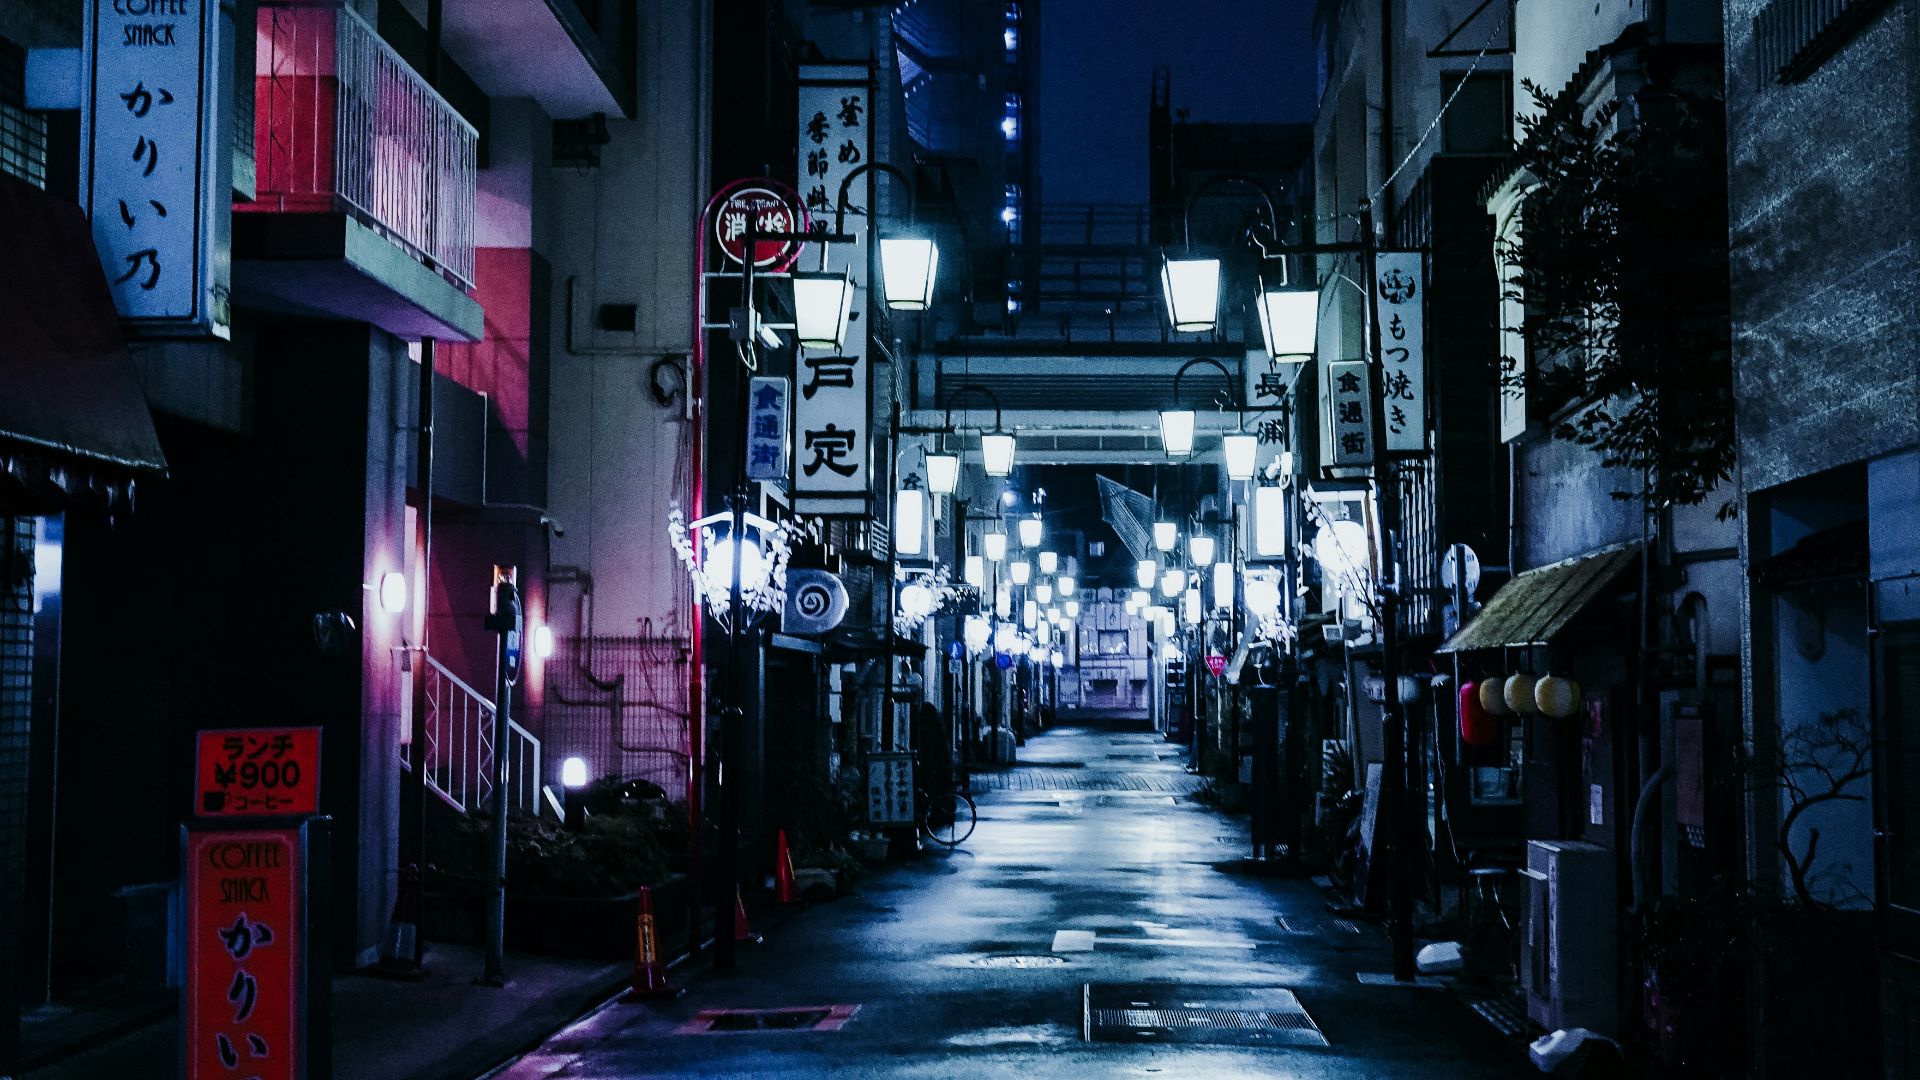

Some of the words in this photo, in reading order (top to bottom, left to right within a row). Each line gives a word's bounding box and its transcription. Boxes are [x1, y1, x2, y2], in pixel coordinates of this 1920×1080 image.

[113, 0, 187, 15] COFFEE
[122, 23, 176, 47] SNACK
[114, 80, 174, 291] かりい乃
[725, 211, 787, 242] 消栓
[1384, 313, 1414, 434] もつ焼き
[803, 312, 860, 477] 戸定
[1336, 371, 1365, 454] 食通街
[1255, 373, 1288, 487] 長浦
[222, 735, 294, 760] ランチ
[215, 760, 300, 788] ¥900
[236, 794, 294, 810] コーヒー
[209, 844, 281, 870] COFFEE
[220, 879, 271, 904] SNACK
[216, 913, 275, 1080] かりい
